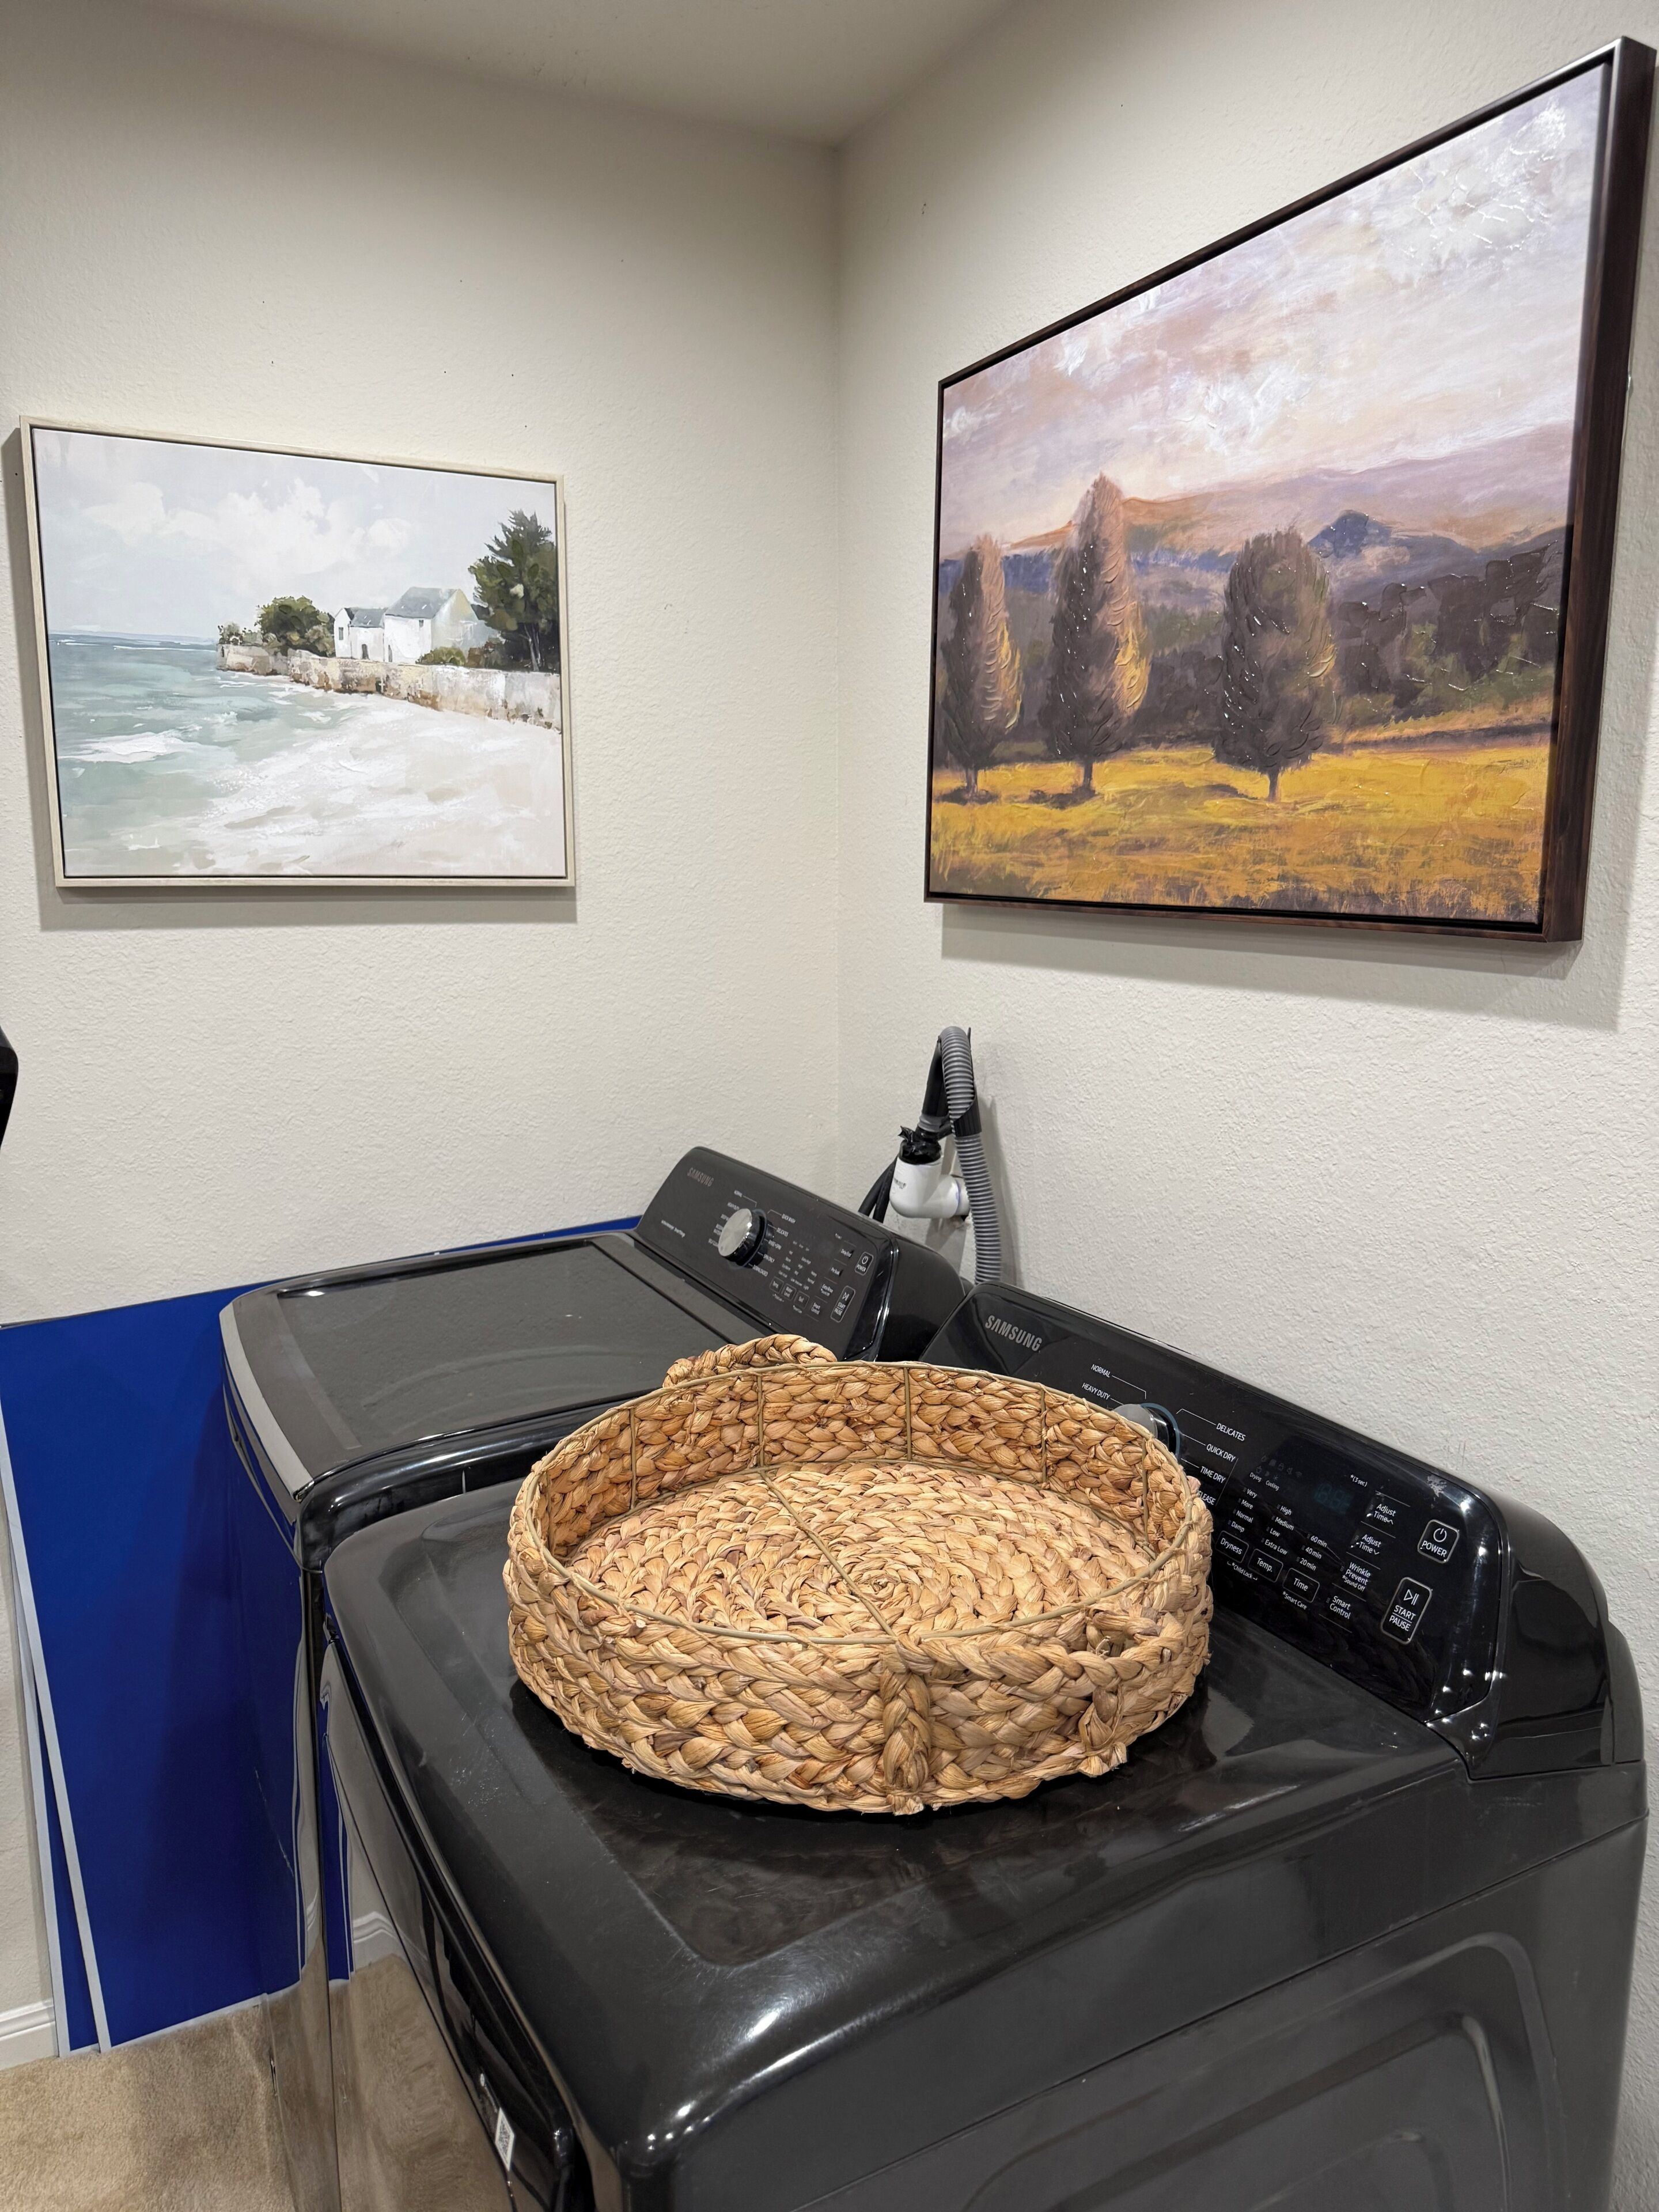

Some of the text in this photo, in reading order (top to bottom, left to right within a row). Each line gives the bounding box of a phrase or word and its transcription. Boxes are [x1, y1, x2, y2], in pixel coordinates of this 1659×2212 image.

[687, 1167, 714, 1187] SAMSUNG
[857, 1264, 866, 1272] POWER
[985, 1315, 1043, 1351] SAMSUNG
[1091, 1364, 1110, 1377] NORMAL
[1082, 1382, 1110, 1400] HEAVY DUTY
[1216, 1423, 1246, 1441] DELICATES
[1206, 1444, 1236, 1463] QUICK DRY
[1200, 1466, 1226, 1484] TIME DRY
[1249, 1472, 1262, 1482] Drying
[1266, 1480, 1279, 1491] Cooling
[1198, 1490, 1216, 1505] ELEASE
[1247, 1488, 1257, 1498] Very
[1241, 1499, 1253, 1510] More
[1280, 1505, 1292, 1516] High
[1376, 1503, 1396, 1517] Adjust
[1236, 1510, 1253, 1523] Normal
[1374, 1510, 1388, 1523] Time
[1231, 1521, 1245, 1533] Damp
[1275, 1517, 1294, 1531] Medium
[1270, 1528, 1280, 1537] Low
[1220, 1538, 1243, 1555] Dryness
[1264, 1539, 1287, 1555] Extra Low
[1358, 1541, 1373, 1554] Time
[1362, 1534, 1381, 1548] Adjust
[1422, 1540, 1447, 1557] POWER
[1257, 1557, 1272, 1573] Temp.
[1349, 1562, 1371, 1578] Wrinkle
[1243, 1570, 1252, 1579] Lock
[1346, 1569, 1368, 1585] Prevent
[1293, 1578, 1308, 1591] Time
[1357, 1584, 1366, 1592] Off
[1297, 1600, 1307, 1610] Care
[1332, 1596, 1351, 1610] Smart
[1330, 1603, 1351, 1620] Control
[1393, 1605, 1416, 1620] START
[1389, 1615, 1411, 1632] PAUSE
